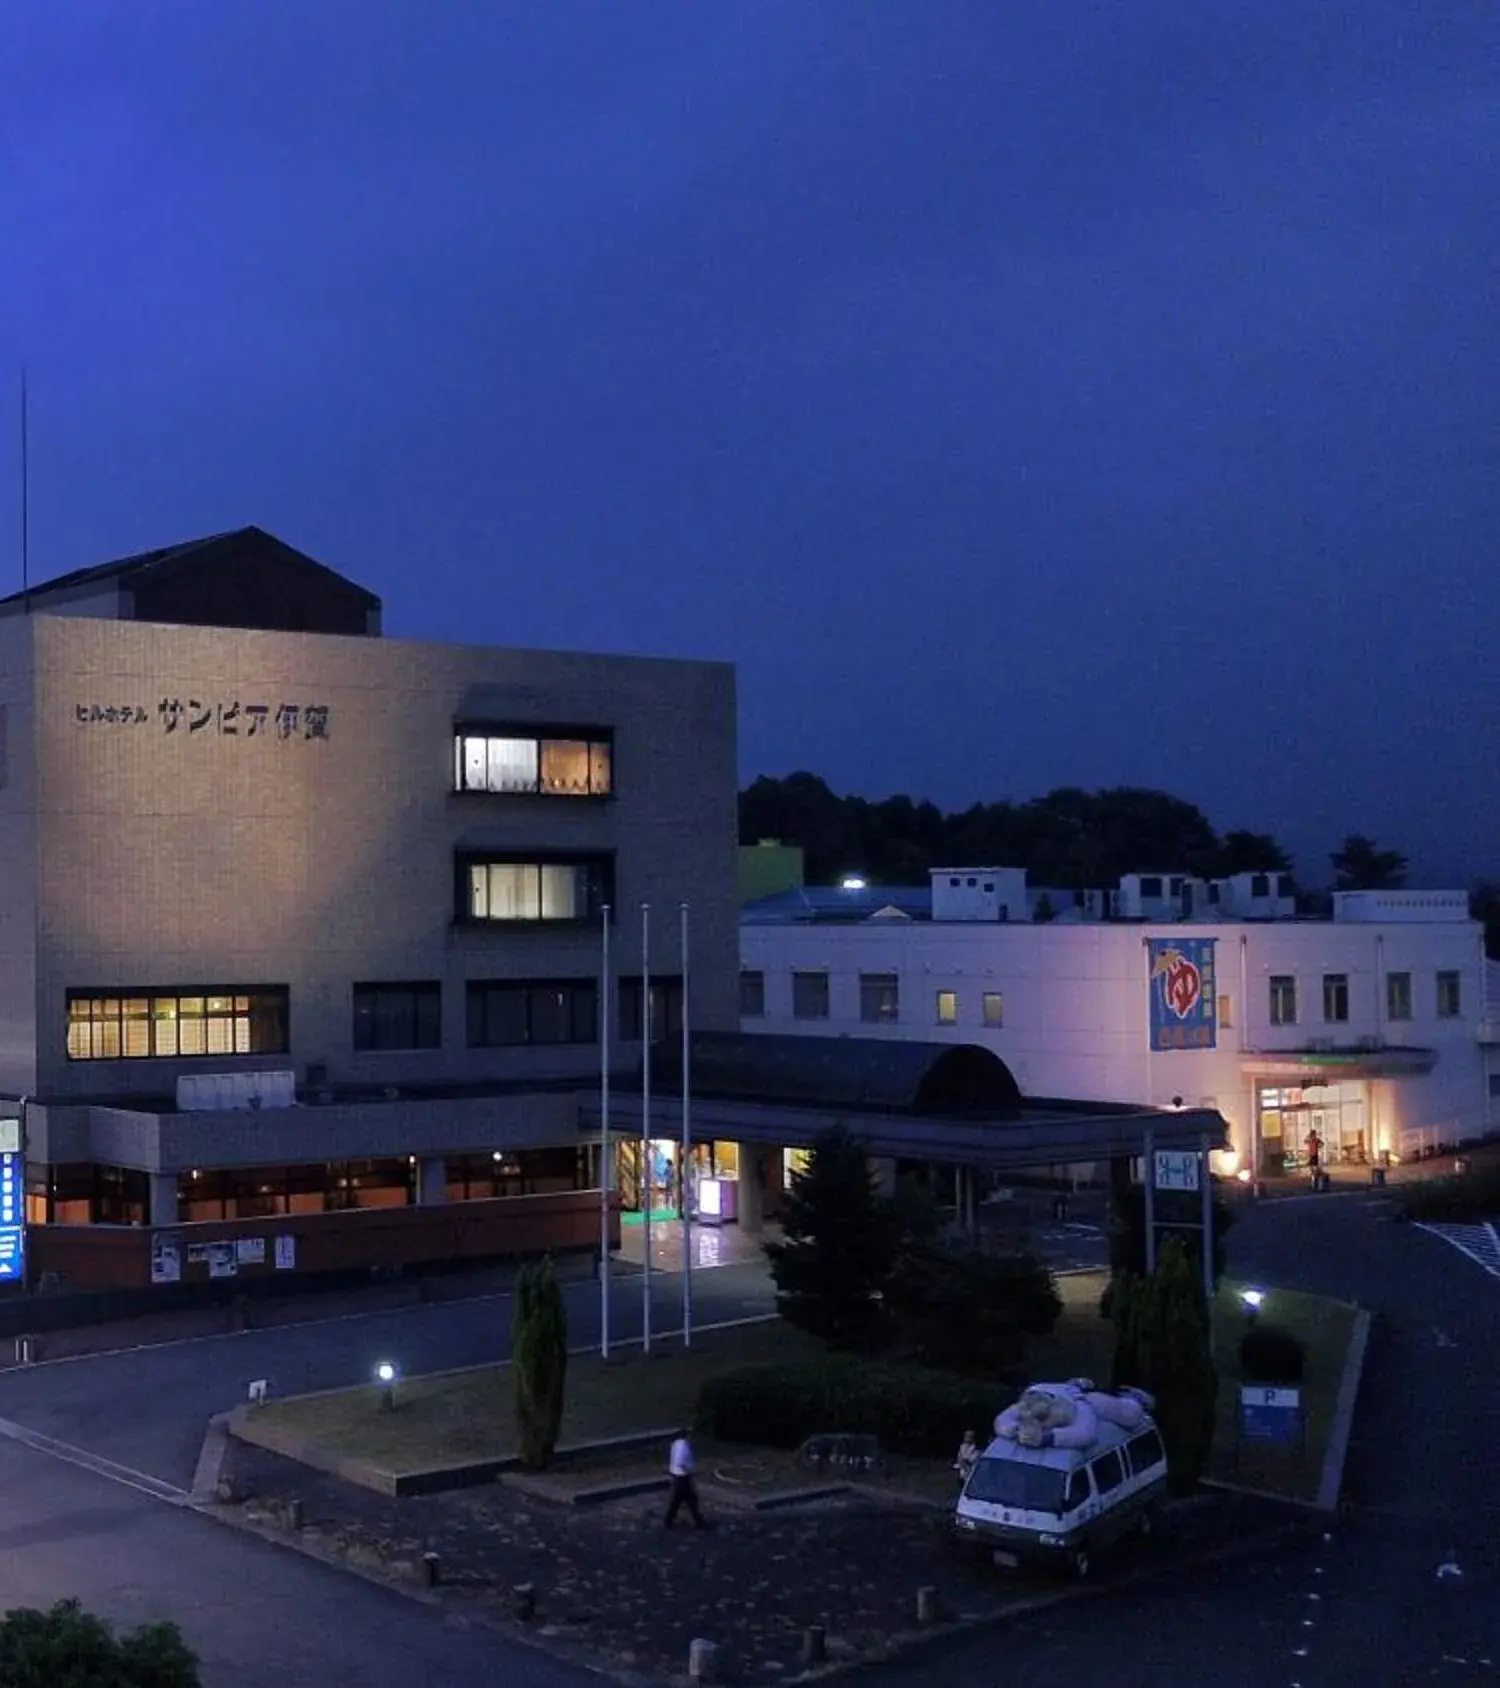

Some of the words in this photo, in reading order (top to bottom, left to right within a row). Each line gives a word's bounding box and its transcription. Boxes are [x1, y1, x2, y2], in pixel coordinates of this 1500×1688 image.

[75, 703, 148, 724] ヒルホテル
[158, 697, 330, 740] サンピア伊賀
